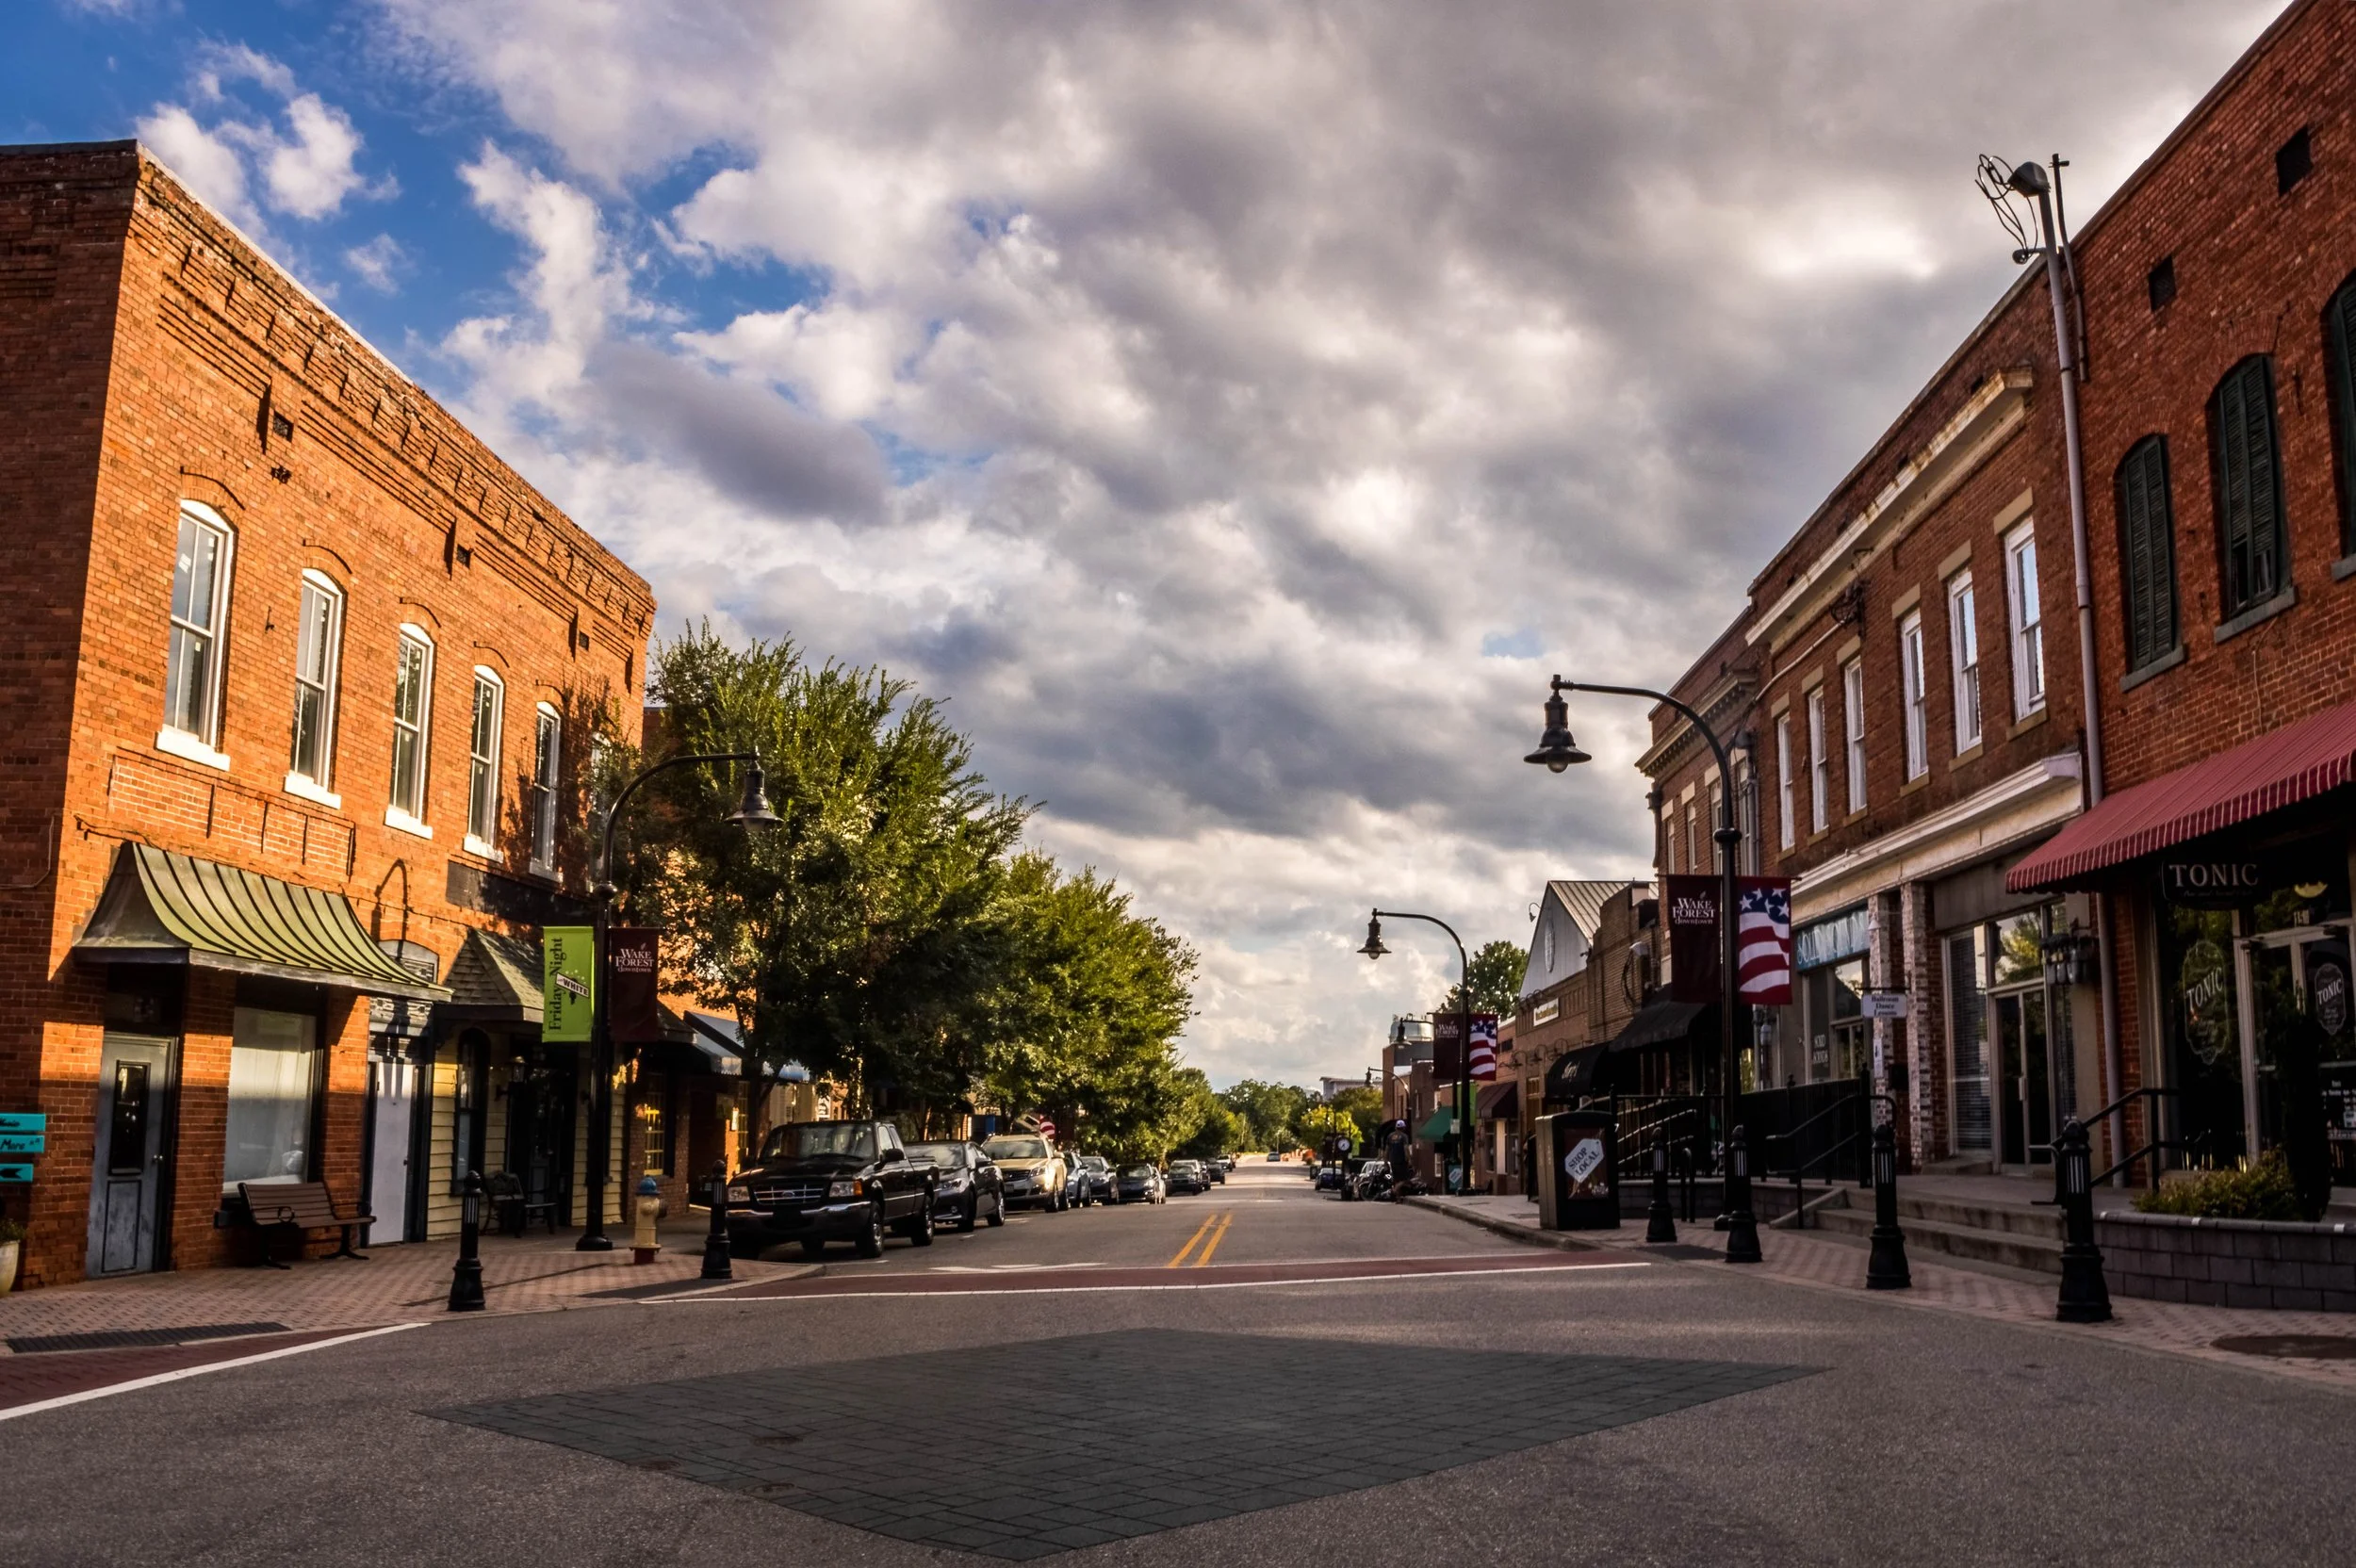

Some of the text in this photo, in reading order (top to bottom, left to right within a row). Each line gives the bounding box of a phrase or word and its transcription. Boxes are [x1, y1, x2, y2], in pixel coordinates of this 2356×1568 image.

[2169, 863, 2259, 888] TONIC
[1672, 906, 1715, 919] FOREST
[1677, 898, 1712, 909] WAKE
[1675, 916, 1713, 924] downtown
[614, 956, 654, 967] FOREST
[620, 948, 651, 958] WAKE
[617, 965, 652, 973] downtown
[548, 938, 566, 1030] Friday Night
[563, 977, 589, 996] WHITE
[2186, 967, 2222, 1013] TONIC
[2317, 978, 2342, 1005] TONIC
[1568, 1147, 1587, 1169] SHOP
[1575, 1151, 1599, 1175] LOCAL
